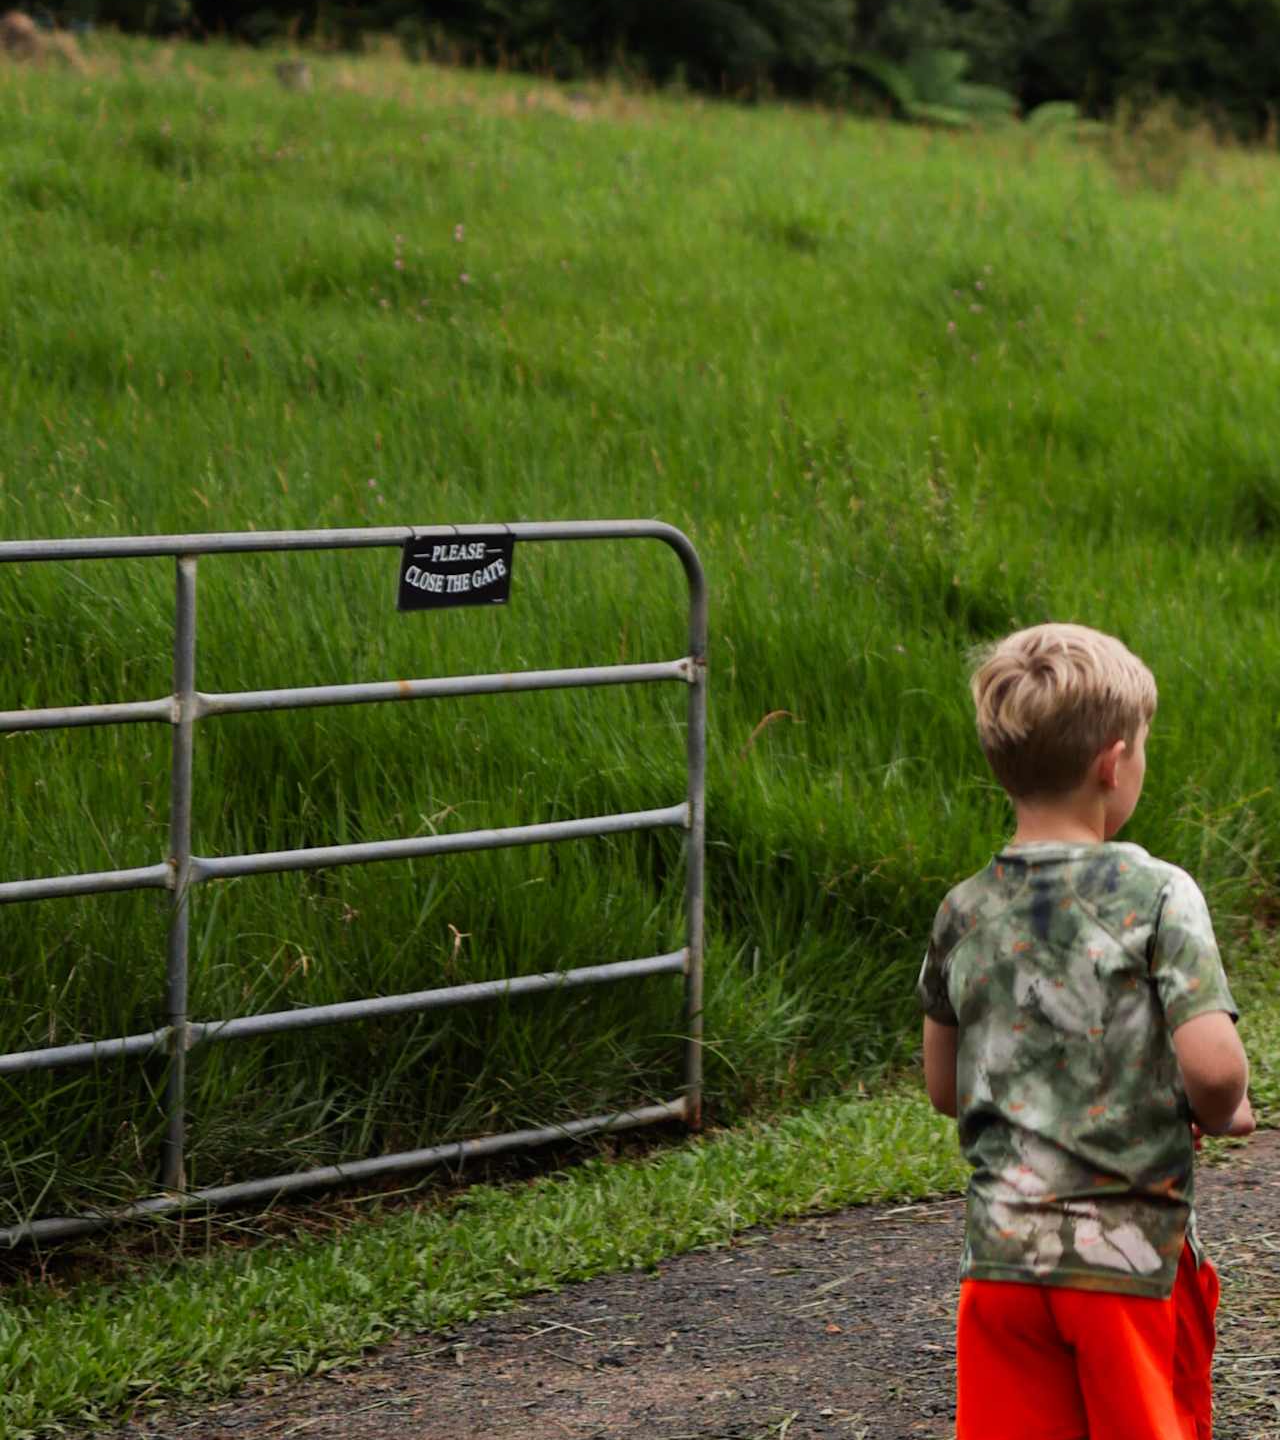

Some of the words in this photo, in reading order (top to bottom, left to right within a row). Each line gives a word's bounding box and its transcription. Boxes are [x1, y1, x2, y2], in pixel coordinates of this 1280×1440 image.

[432, 542, 486, 562] PLEASE
[405, 565, 445, 593] CLOSE
[446, 573, 471, 592] THE
[472, 558, 506, 588] GATE
